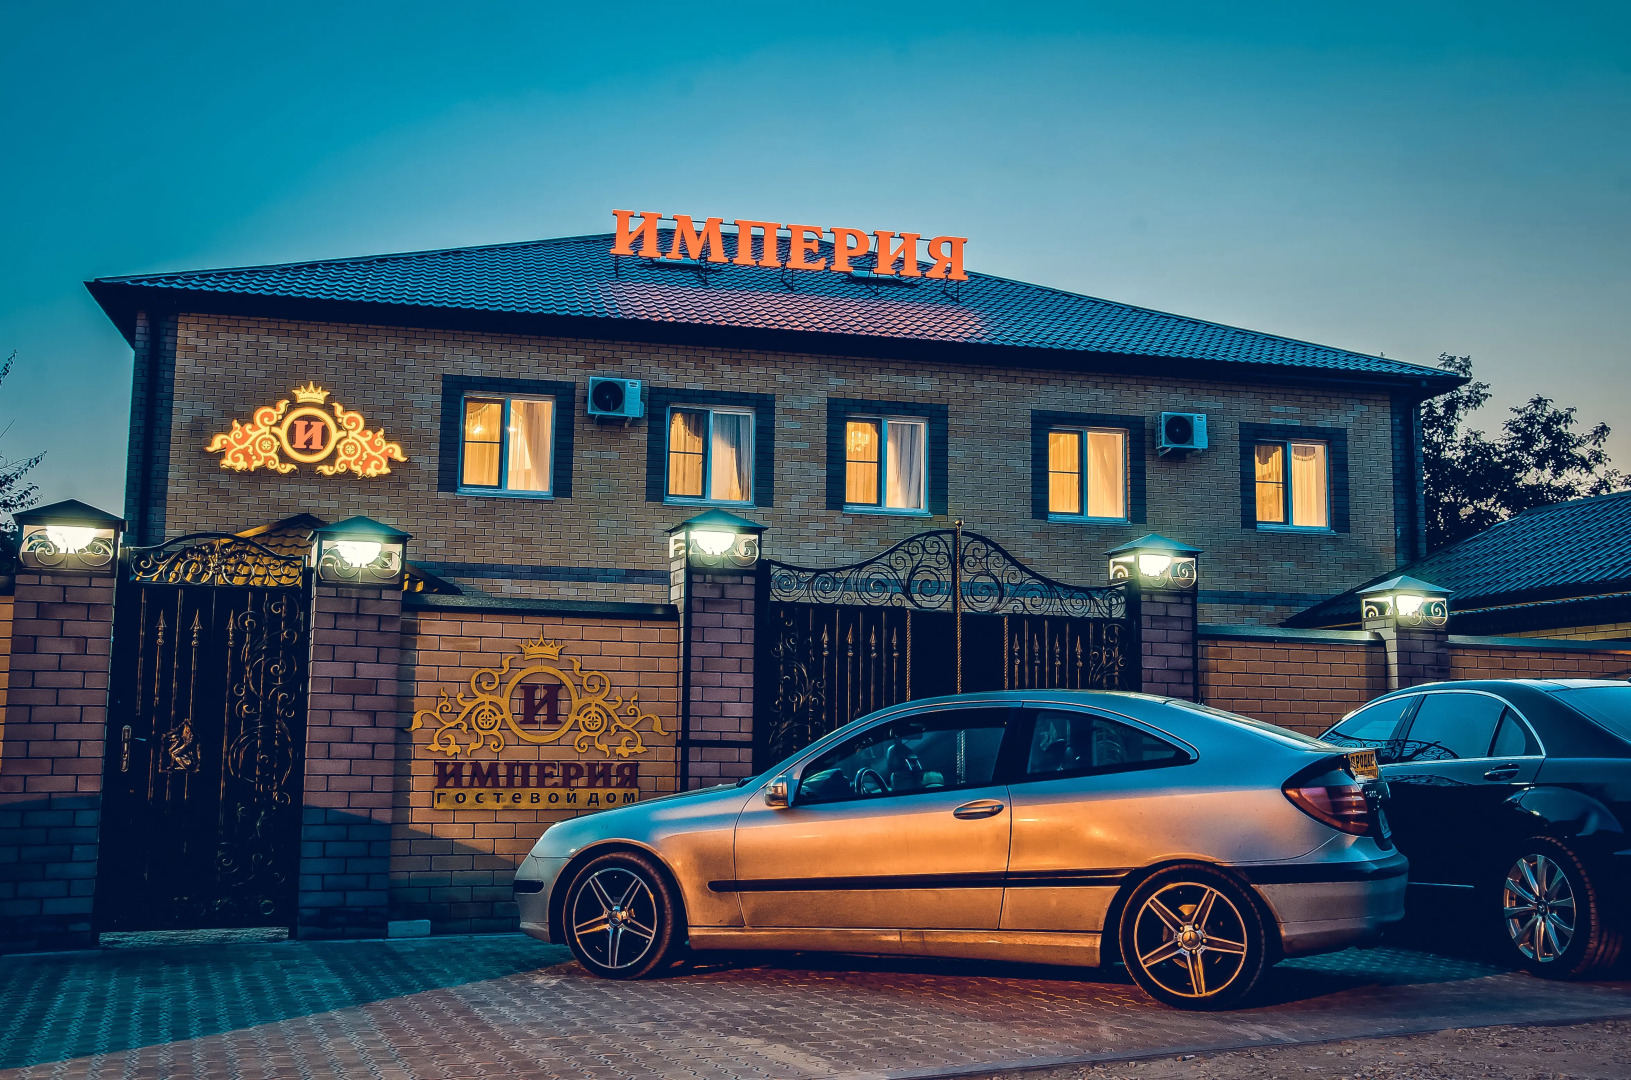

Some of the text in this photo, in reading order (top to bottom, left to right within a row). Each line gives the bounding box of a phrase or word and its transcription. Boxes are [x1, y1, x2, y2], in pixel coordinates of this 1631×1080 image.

[610, 209, 969, 281] ИМПЕРИЯ
[292, 420, 325, 450] И
[519, 685, 563, 725] И
[434, 761, 640, 789] ИМПЕРИЯ
[436, 788, 636, 807] гостевой дом
